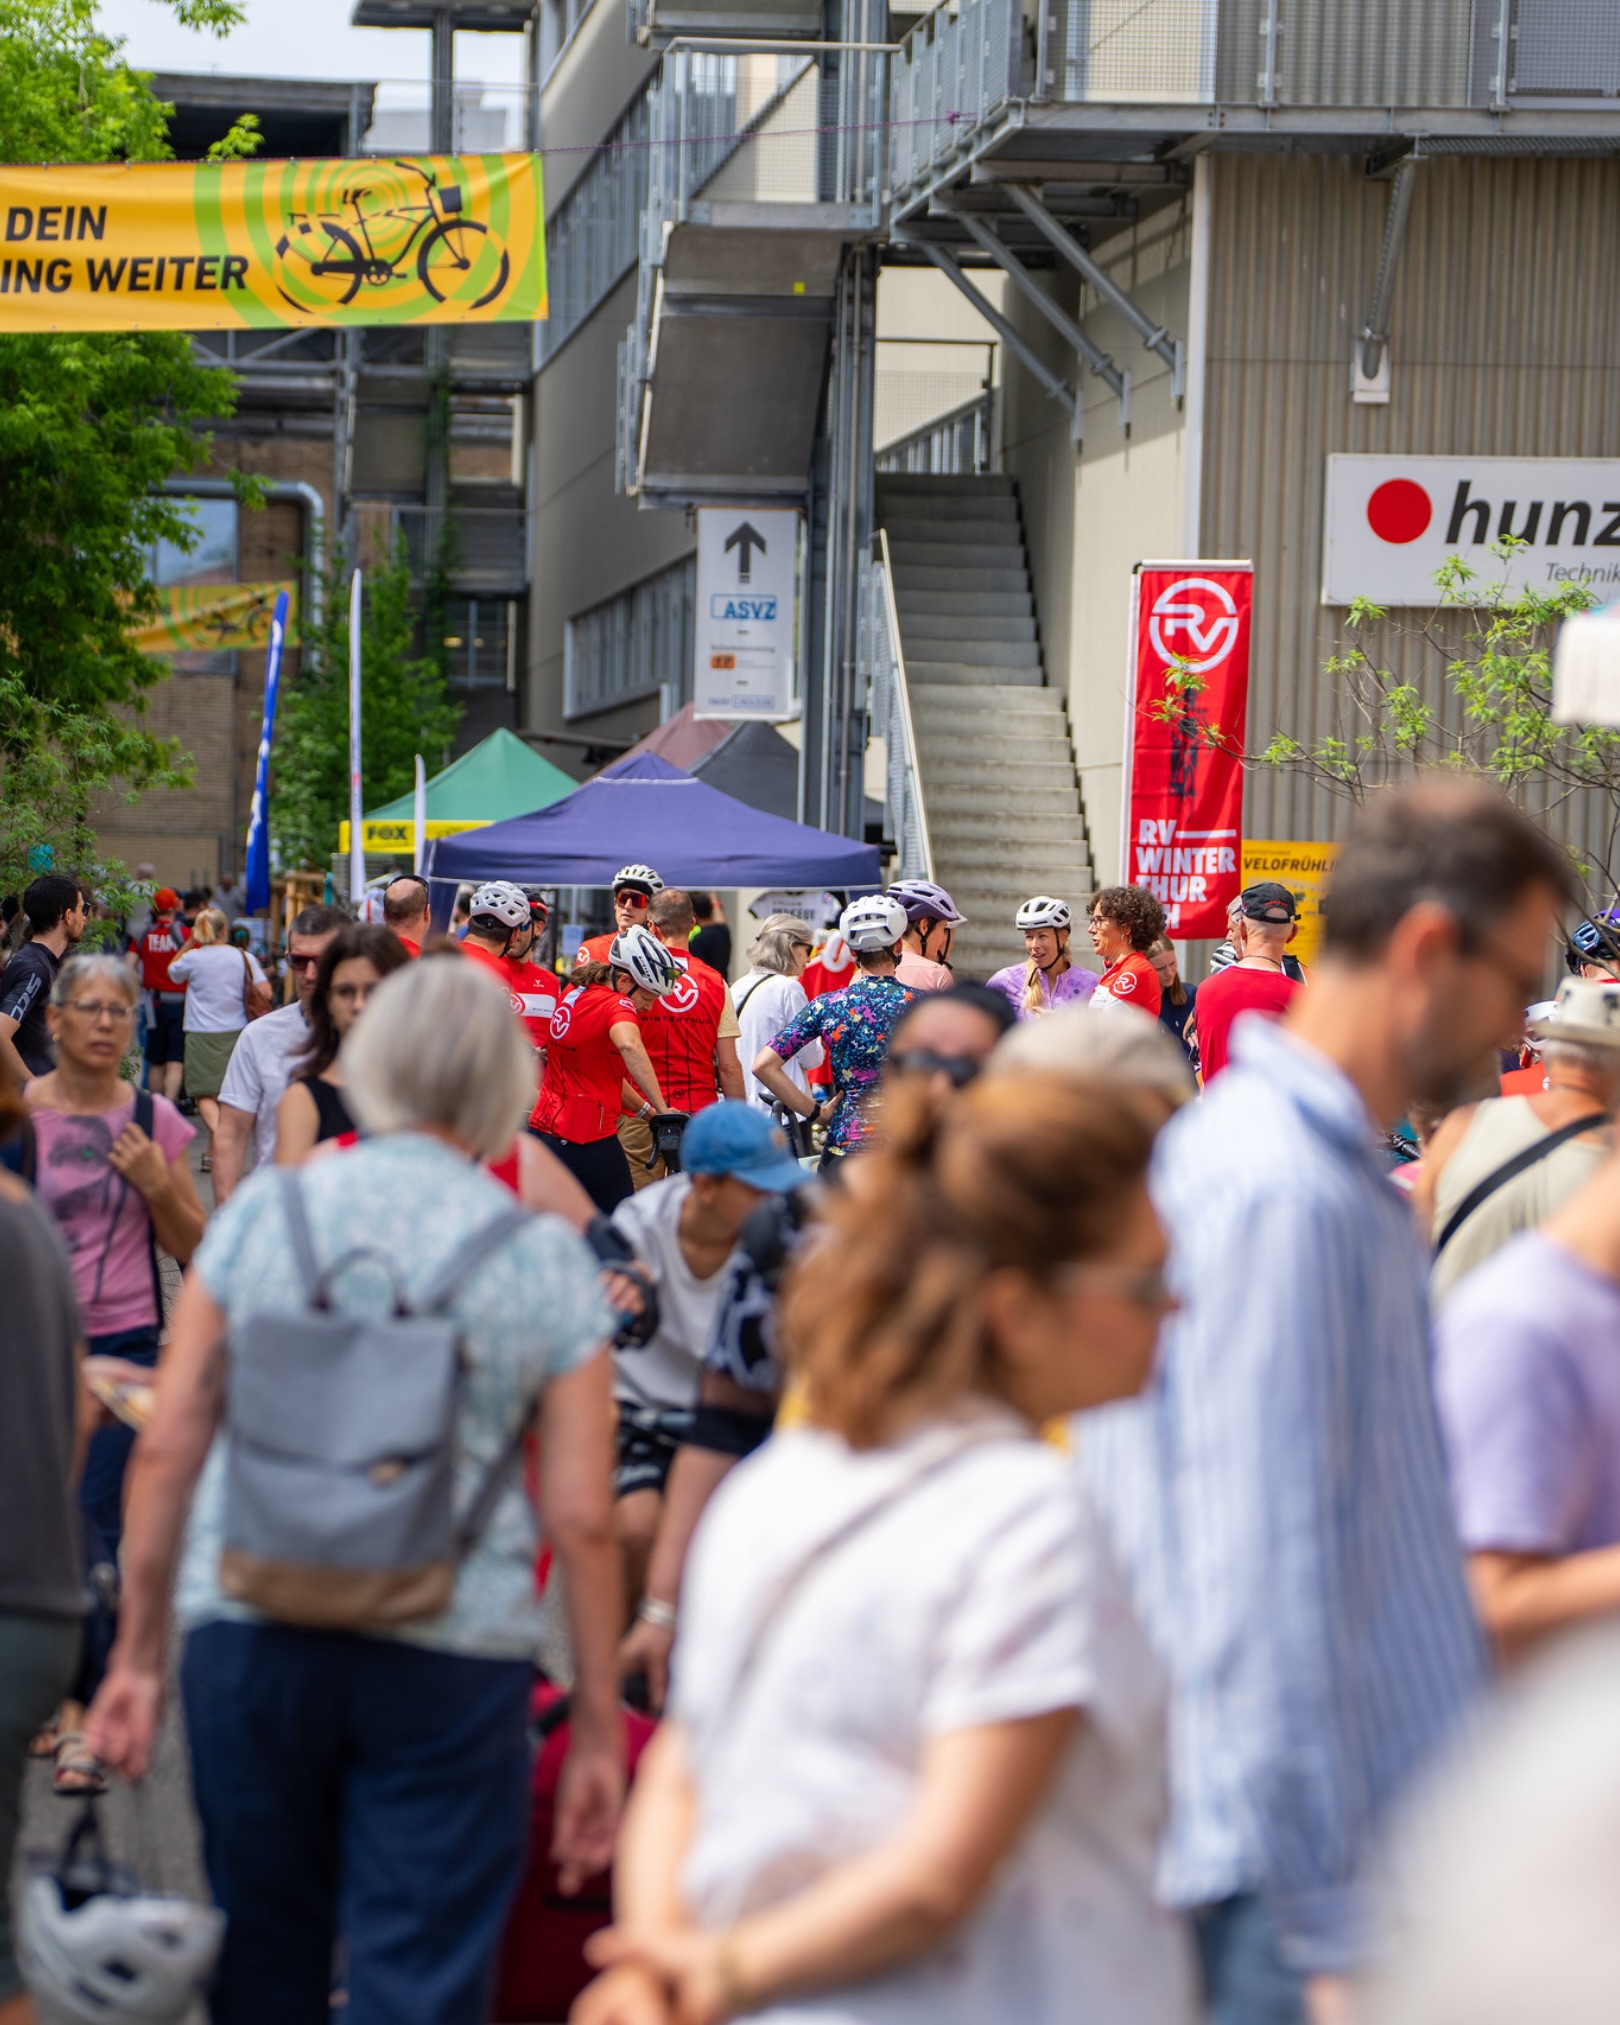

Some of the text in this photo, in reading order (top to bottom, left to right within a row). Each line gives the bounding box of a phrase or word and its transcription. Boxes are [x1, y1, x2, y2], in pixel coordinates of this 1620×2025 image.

[5, 205, 107, 241] DEIN
[86, 255, 249, 292] WEITER
[723, 600, 777, 620] ASVZ
[367, 826, 407, 841] FOX
[1135, 847, 1236, 875] WINTER
[1243, 856, 1338, 872] VELOFRÜHLI
